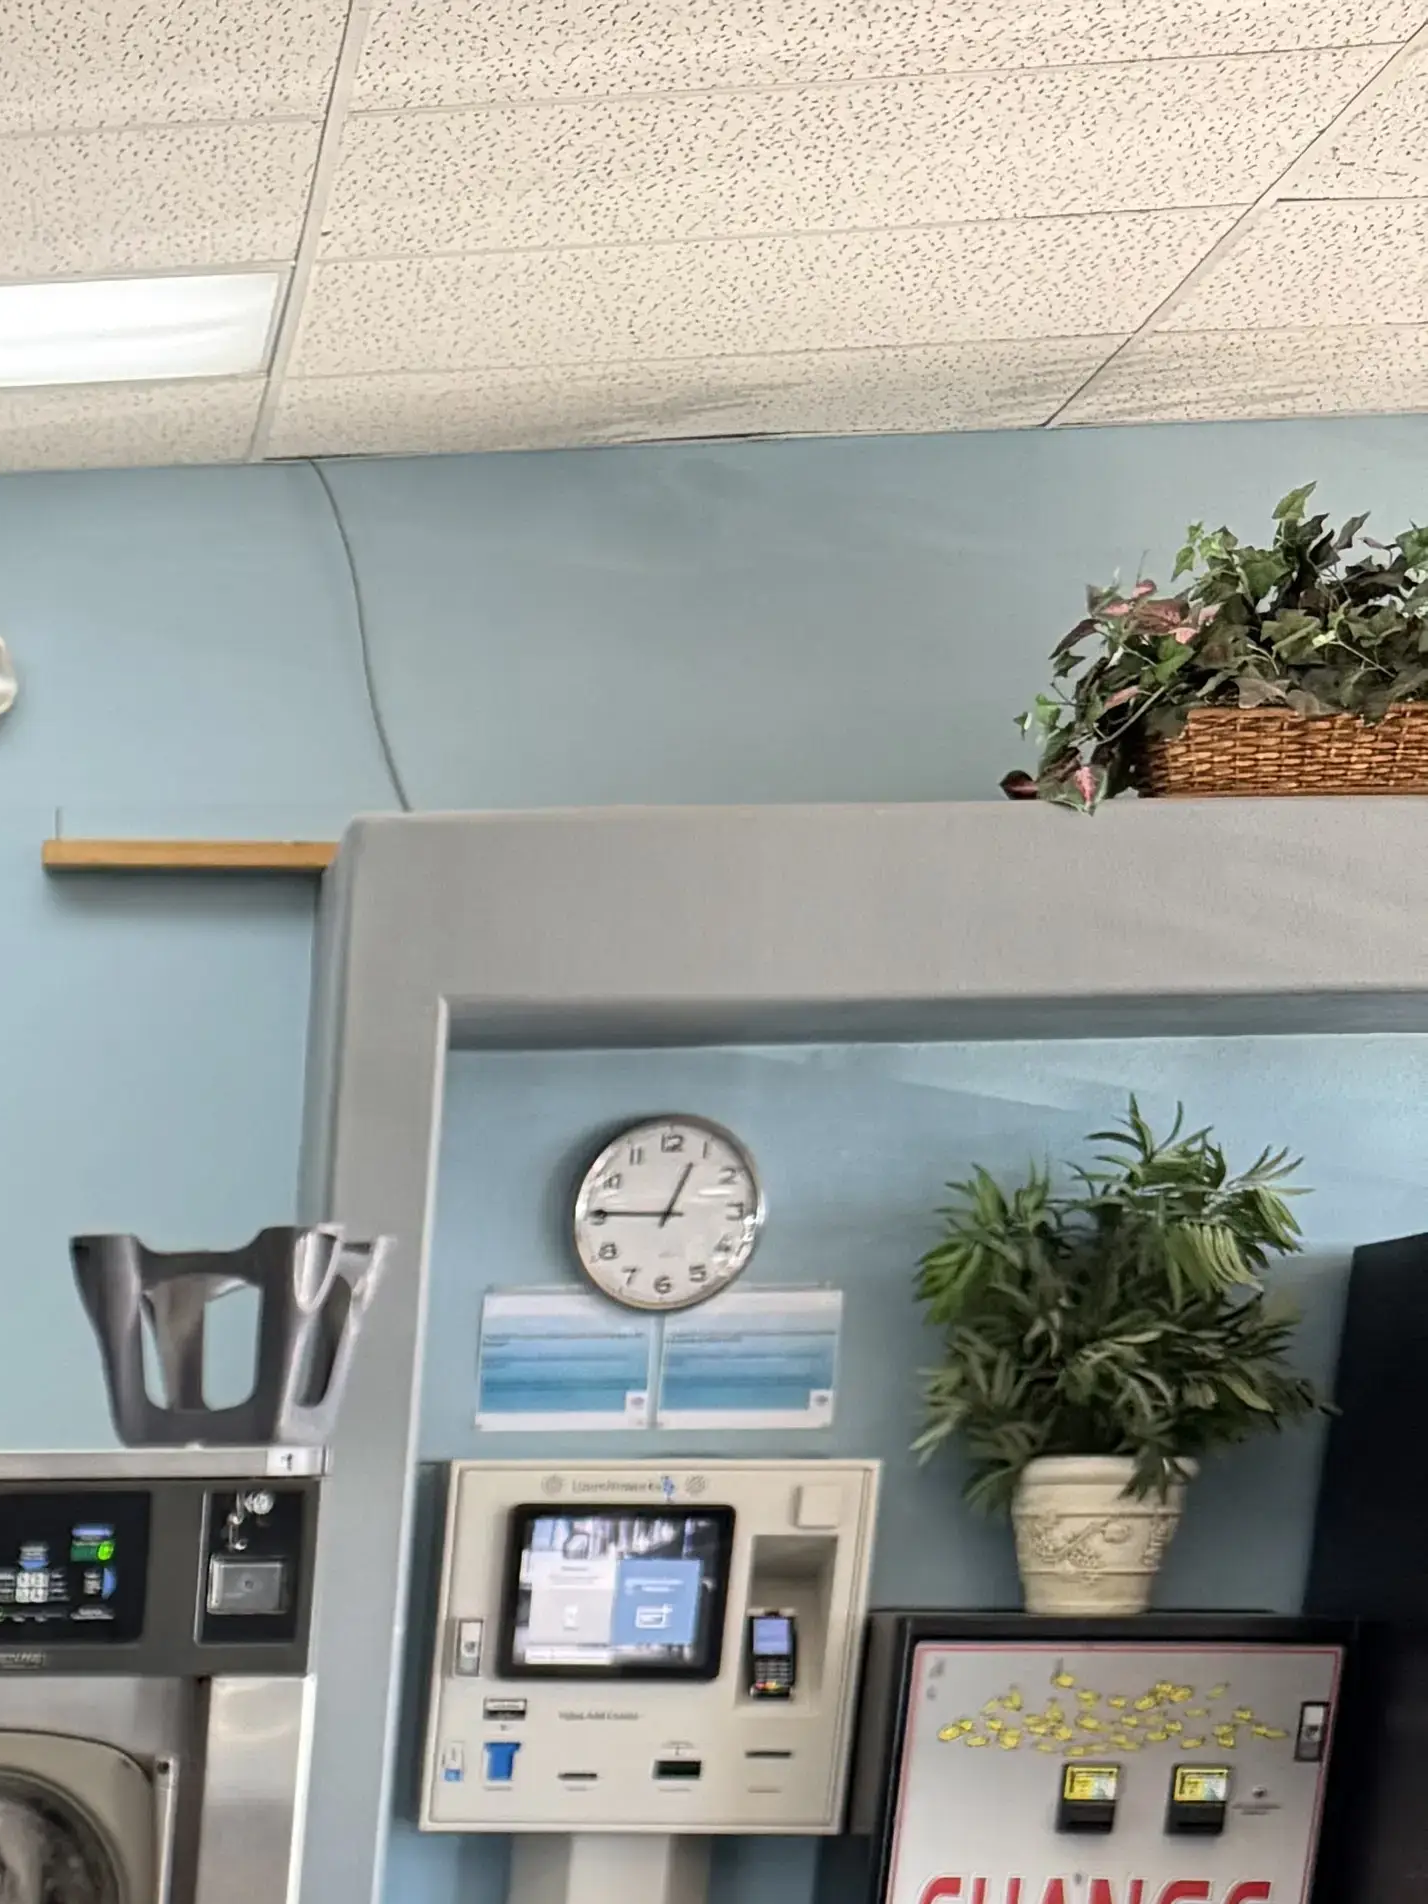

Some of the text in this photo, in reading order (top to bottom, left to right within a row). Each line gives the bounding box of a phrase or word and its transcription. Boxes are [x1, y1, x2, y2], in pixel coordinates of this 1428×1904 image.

[661, 1134, 684, 1153] 12
[629, 1147, 643, 1165] 11
[718, 1167, 737, 1185] 2
[726, 1202, 744, 1221] 3
[599, 1242, 618, 1260] 8
[622, 1267, 641, 1286] 7
[689, 1264, 707, 1283] 5
[654, 1276, 673, 1295] 6
